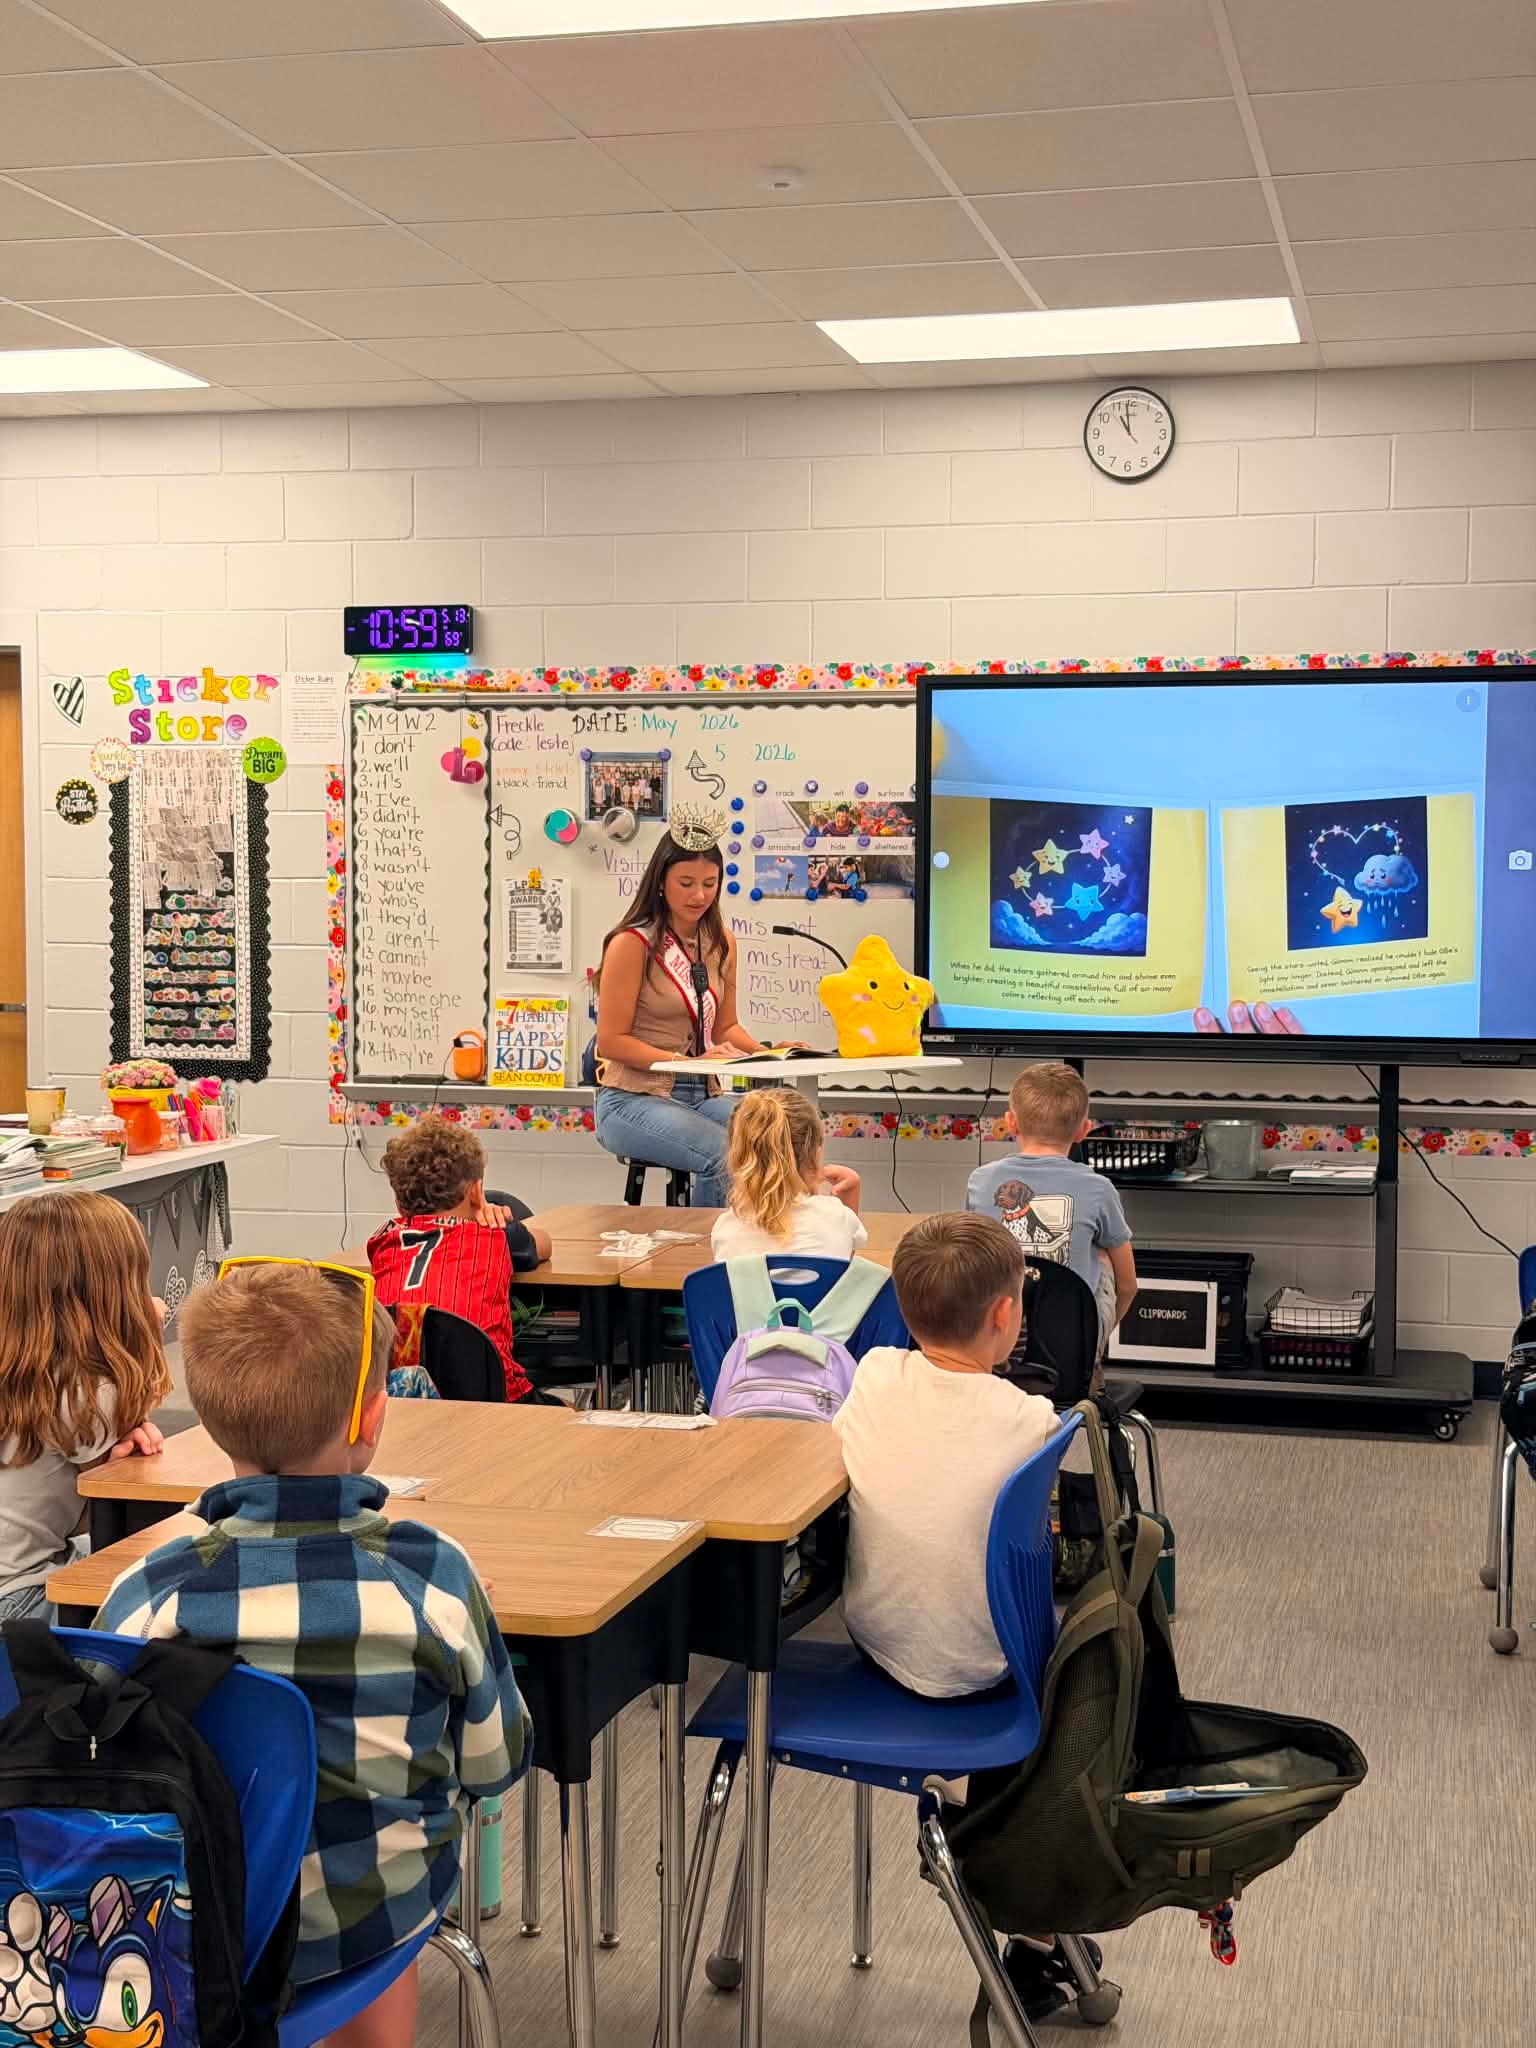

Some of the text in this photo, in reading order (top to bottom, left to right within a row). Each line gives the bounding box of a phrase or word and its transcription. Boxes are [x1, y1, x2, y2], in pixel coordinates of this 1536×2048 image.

[1099, 412, 1110, 424] 10
[1154, 411, 1163, 423] 2
[1092, 428, 1100, 440] 9
[1159, 429, 1167, 440] 3
[1097, 445, 1105, 456] 8
[1153, 445, 1160, 456] 4
[1109, 456, 1117, 467] 7
[1123, 460, 1132, 472] 6
[1140, 456, 1148, 468] 5
[369, 608, 437, 648] 10:59
[108, 667, 279, 706] Sticker
[128, 708, 248, 745] Store
[641, 713, 678, 738] May
[699, 713, 740, 731] 2026
[374, 735, 416, 755] don't
[754, 743, 796, 761] 2026
[246, 747, 282, 763] Dream
[252, 759, 276, 774] BIG
[374, 755, 409, 773] we'll
[376, 773, 402, 790] it's
[69, 789, 87, 799] STAY
[373, 807, 420, 824] didn't
[374, 825, 424, 843] you're
[374, 841, 422, 858] that's
[830, 843, 846, 851] hide
[874, 843, 908, 851] sheltered
[374, 856, 431, 873] wasn't
[377, 877, 425, 896] you've
[379, 892, 419, 909] who's
[377, 908, 426, 929] they'd
[385, 926, 440, 951] aren't
[378, 950, 428, 968] cannot
[747, 943, 830, 970] mistreat
[382, 968, 432, 992] maybe
[505, 1001, 520, 1025] 7
[515, 1011, 565, 1024] HABITS
[380, 1021, 440, 1044] wouldn't
[496, 1030, 564, 1047] HAPPY
[380, 1042, 433, 1070] they're
[494, 1048, 562, 1071] KIDS
[494, 1071, 562, 1083] SEAN COVEY
[399, 1228, 444, 1291] 7
[1138, 1307, 1188, 1321] CLIPBOARDS
